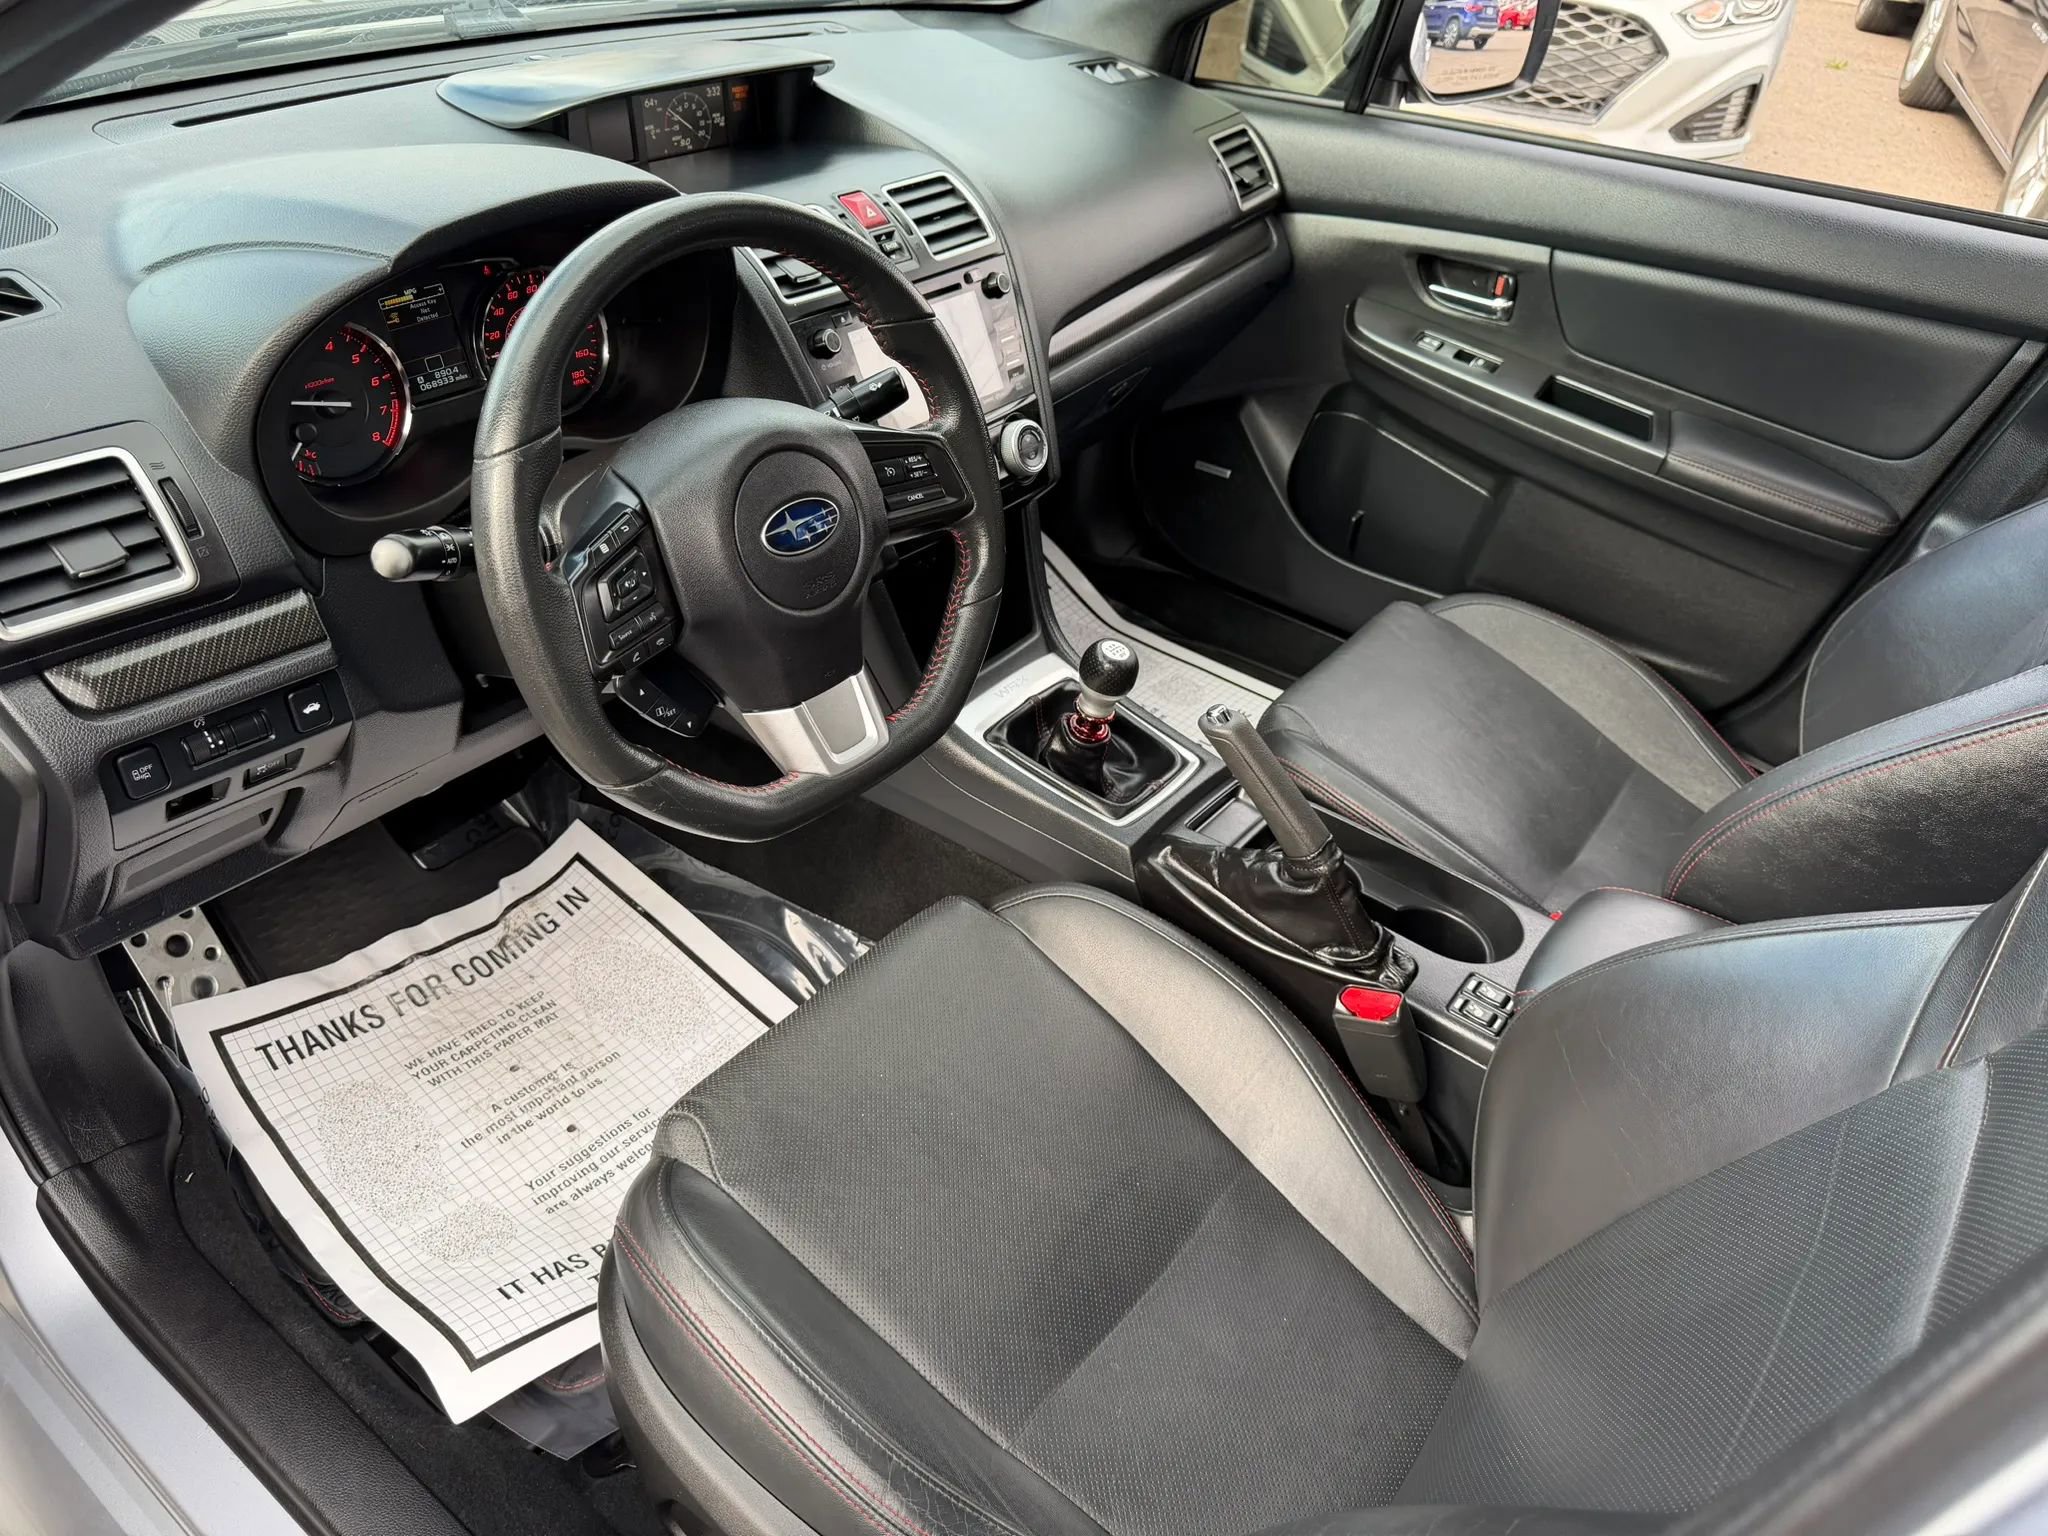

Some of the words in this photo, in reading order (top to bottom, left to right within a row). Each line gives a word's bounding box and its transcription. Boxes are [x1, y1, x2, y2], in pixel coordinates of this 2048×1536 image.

[526, 284, 538, 294] 80
[507, 290, 518, 300] 60
[493, 307, 504, 316] 40
[489, 331, 500, 340] 20
[325, 341, 334, 351] 4
[575, 348, 589, 358] 160
[351, 354, 360, 364] 5
[572, 369, 585, 379] 180
[371, 377, 380, 387] 6
[420, 376, 455, 391] 068933
[379, 405, 388, 415] 7
[372, 432, 380, 441] 8
[140, 763, 153, 773] OFF
[267, 759, 280, 769] OFF
[254, 1004, 386, 1071] THANKS
[387, 974, 451, 1017] FOR
[451, 912, 560, 986] COMING
[557, 886, 591, 917] IN
[404, 1056, 426, 1070] WE
[427, 1037, 462, 1058] HAVE
[462, 1018, 497, 1041] TRIED
[498, 1008, 516, 1020] TO
[516, 991, 545, 1010] KEEP
[412, 1060, 449, 1080] YOUR
[450, 1020, 517, 1062] CARPETING
[519, 999, 557, 1023] CLEAN
[427, 1066, 463, 1087] WITH
[463, 1049, 492, 1070] THIS
[493, 1026, 534, 1050] PAPER
[534, 1012, 560, 1029] MAT
[491, 1103, 501, 1113] A
[504, 1070, 559, 1106] customer
[560, 1061, 574, 1072] is
[461, 1133, 483, 1149] the
[486, 1110, 518, 1135] most
[519, 1074, 577, 1114] important
[580, 1051, 621, 1079] person
[498, 1132, 511, 1144] in
[511, 1119, 533, 1135] the
[535, 1095, 571, 1120] world
[572, 1088, 585, 1098] to
[525, 1169, 556, 1191] Your
[558, 1119, 633, 1171] suggestions
[632, 1107, 651, 1121] for
[531, 1161, 599, 1206] improving
[600, 1145, 621, 1164] our
[622, 1117, 660, 1148] servic
[545, 1199, 568, 1214] are
[570, 1169, 615, 1201] always
[616, 1140, 654, 1170] welco
[497, 1279, 525, 1300] IT
[530, 1253, 590, 1285] HAS
